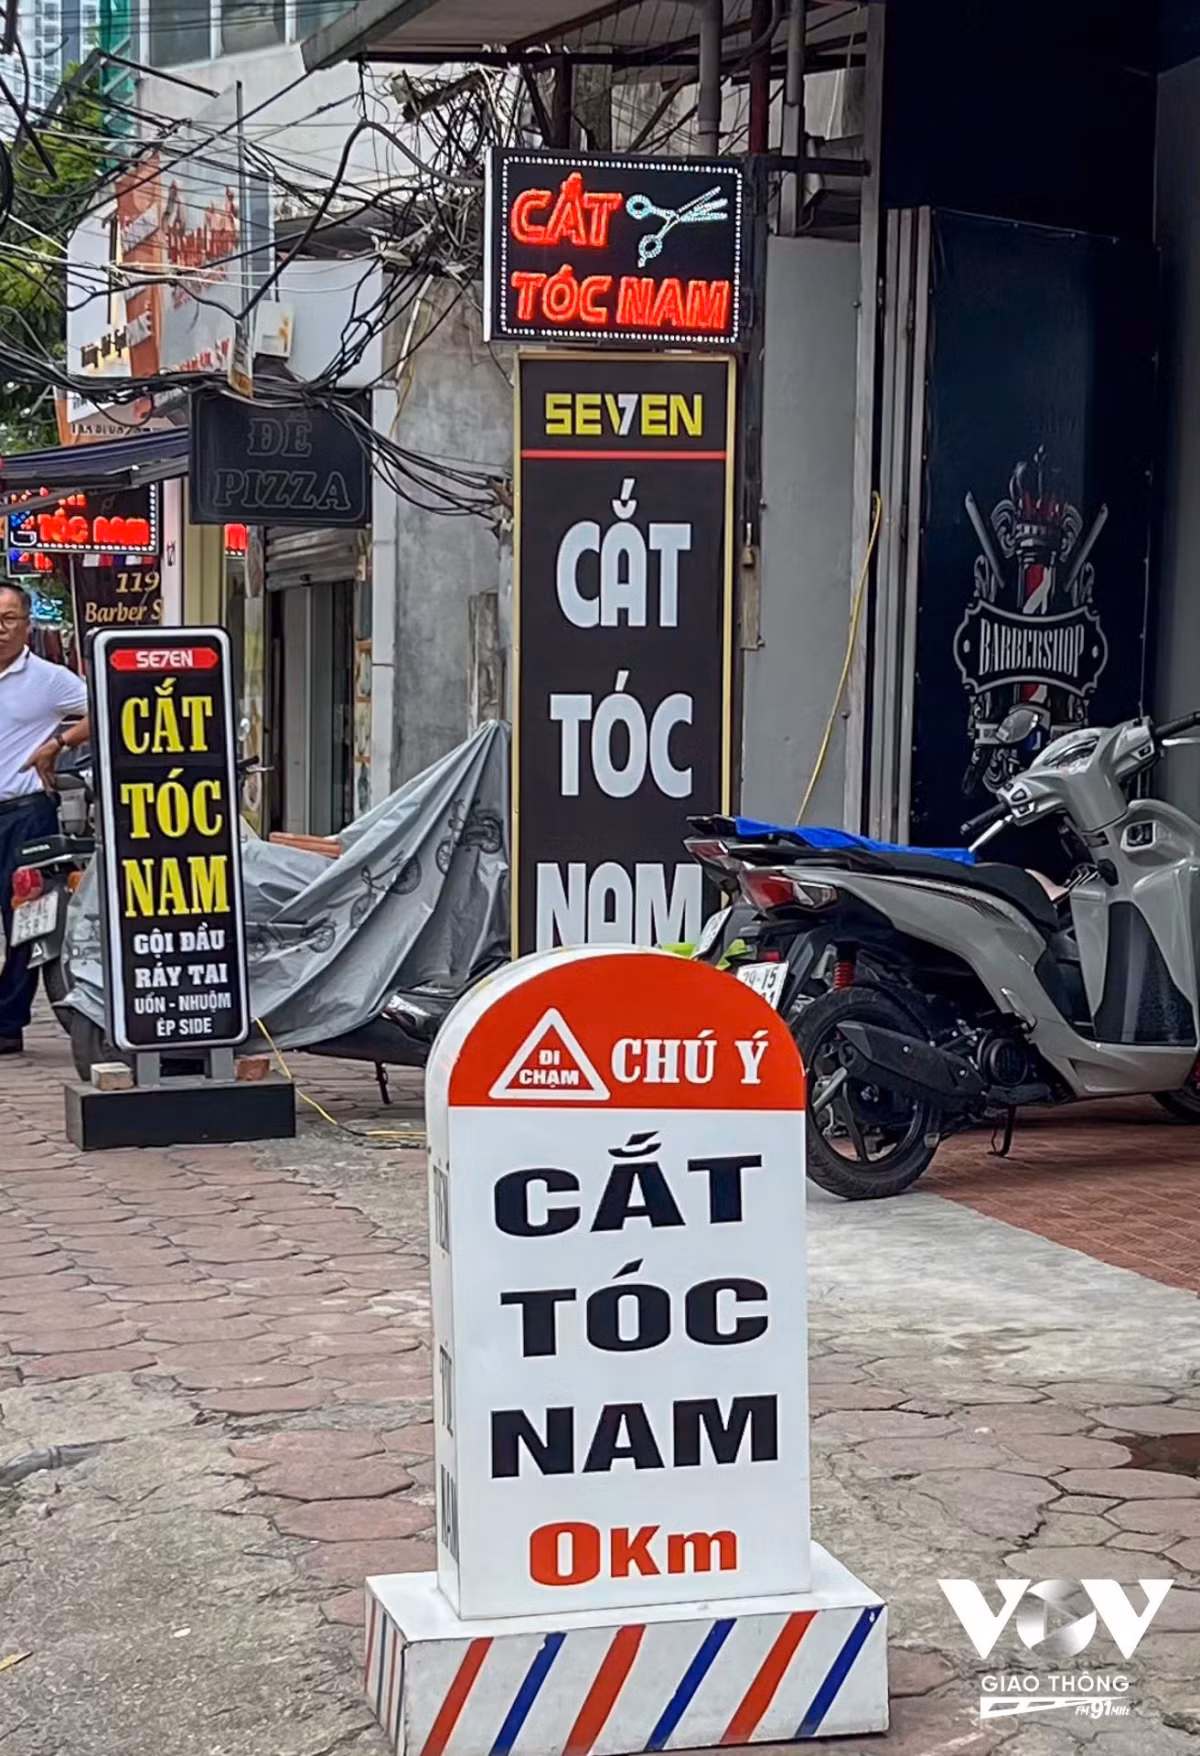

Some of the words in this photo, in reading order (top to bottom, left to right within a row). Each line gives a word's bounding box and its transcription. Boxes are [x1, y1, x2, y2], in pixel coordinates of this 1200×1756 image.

[511, 264, 613, 324] TÓC
[616, 276, 729, 329] NAM
[213, 469, 351, 511] PIZZA
[115, 572, 160, 593] 119
[556, 478, 692, 628] CẮT
[85, 602, 147, 623] Barber
[978, 618, 1084, 678] BARBERSHOP
[120, 677, 213, 754] CẮT
[550, 670, 693, 798] TÓC
[120, 768, 223, 839] TÓC
[122, 855, 230, 917] NAM
[536, 862, 703, 951] NAM
[134, 927, 174, 959] GỘI
[179, 922, 225, 952] ĐẦU
[134, 992, 166, 1014] UỐN
[188, 963, 228, 986] TAI
[179, 1018, 212, 1035] SIDE
[611, 1029, 717, 1084] CHÚ
[735, 1030, 769, 1085] Ý
[519, 1069, 580, 1088] CHẠM
[494, 1131, 762, 1237] CẮT
[500, 1258, 768, 1357] TÓC
[491, 1394, 778, 1479] NAM
